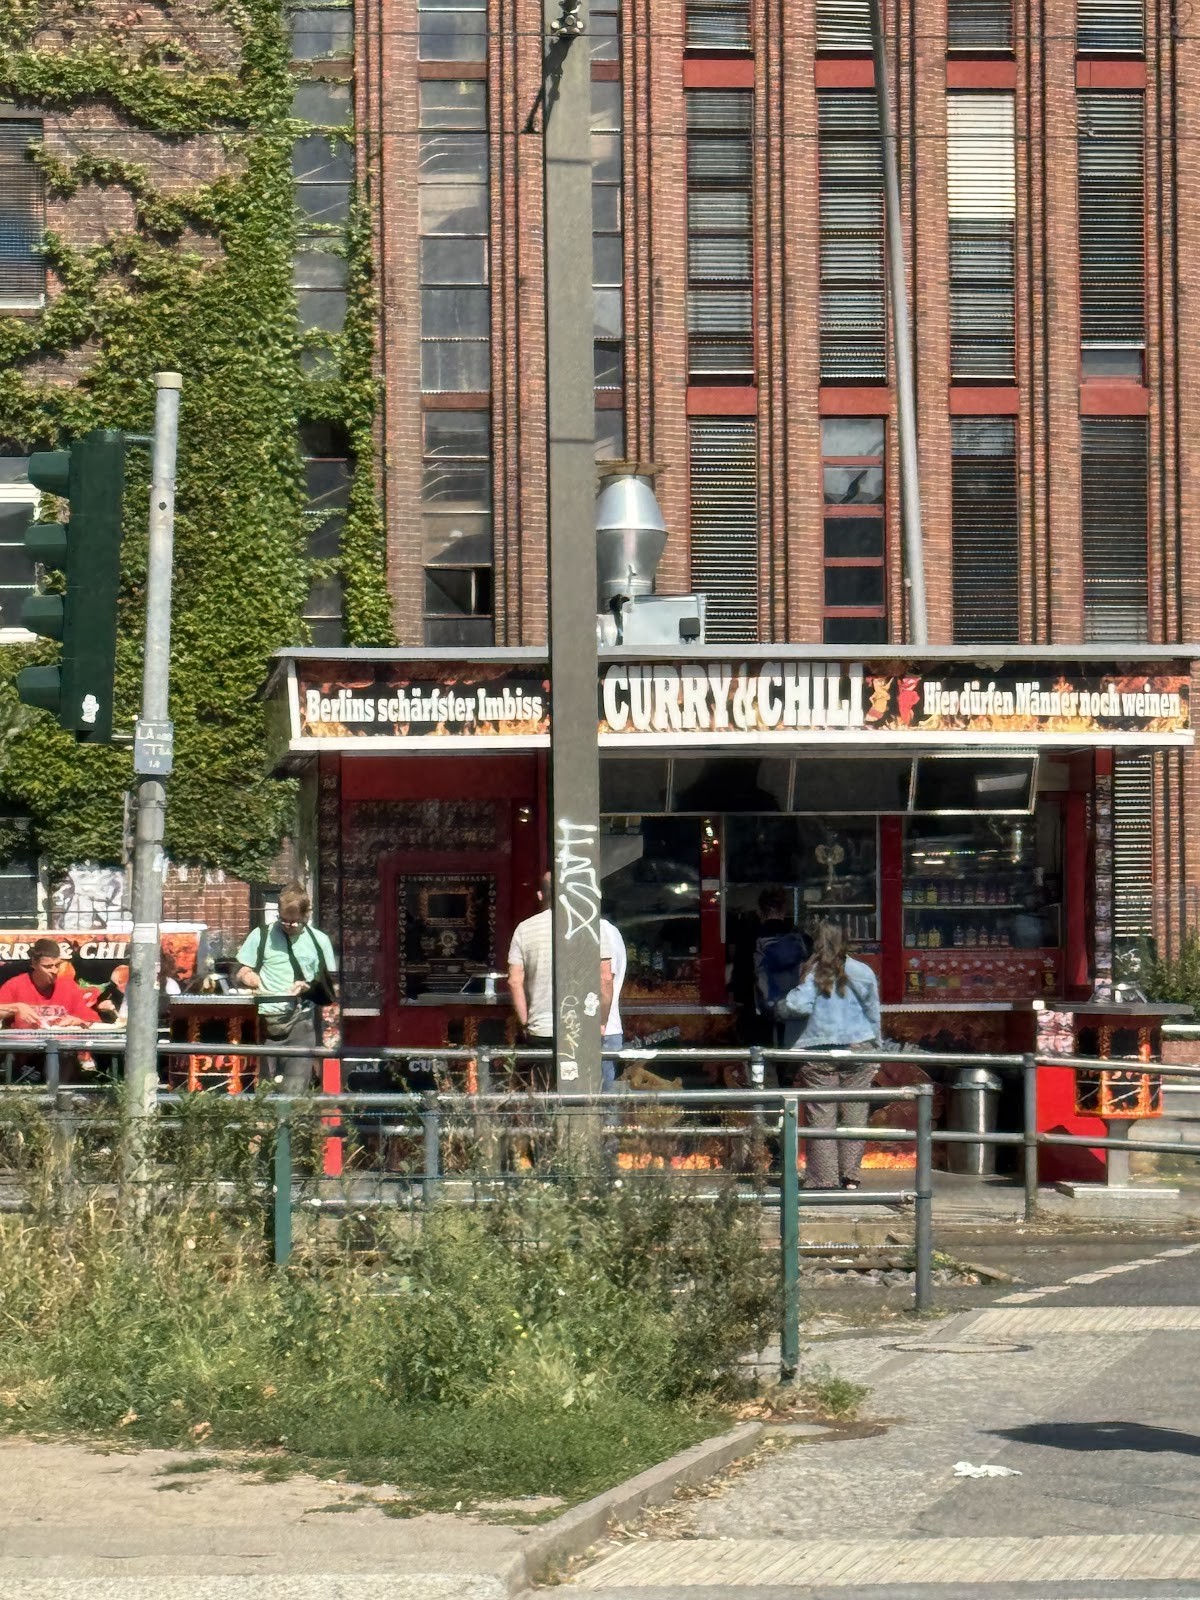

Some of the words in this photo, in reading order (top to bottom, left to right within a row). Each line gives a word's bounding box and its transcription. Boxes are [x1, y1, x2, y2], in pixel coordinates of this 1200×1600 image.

[305, 689, 375, 723] Berlins
[377, 687, 476, 722] schärfster
[477, 687, 543, 721] Imbiss
[923, 681, 959, 715] Hier
[960, 681, 1014, 716] dürfen
[1015, 681, 1079, 717] Männer
[1079, 684, 1122, 717] noch
[1122, 684, 1181, 718] weinen
